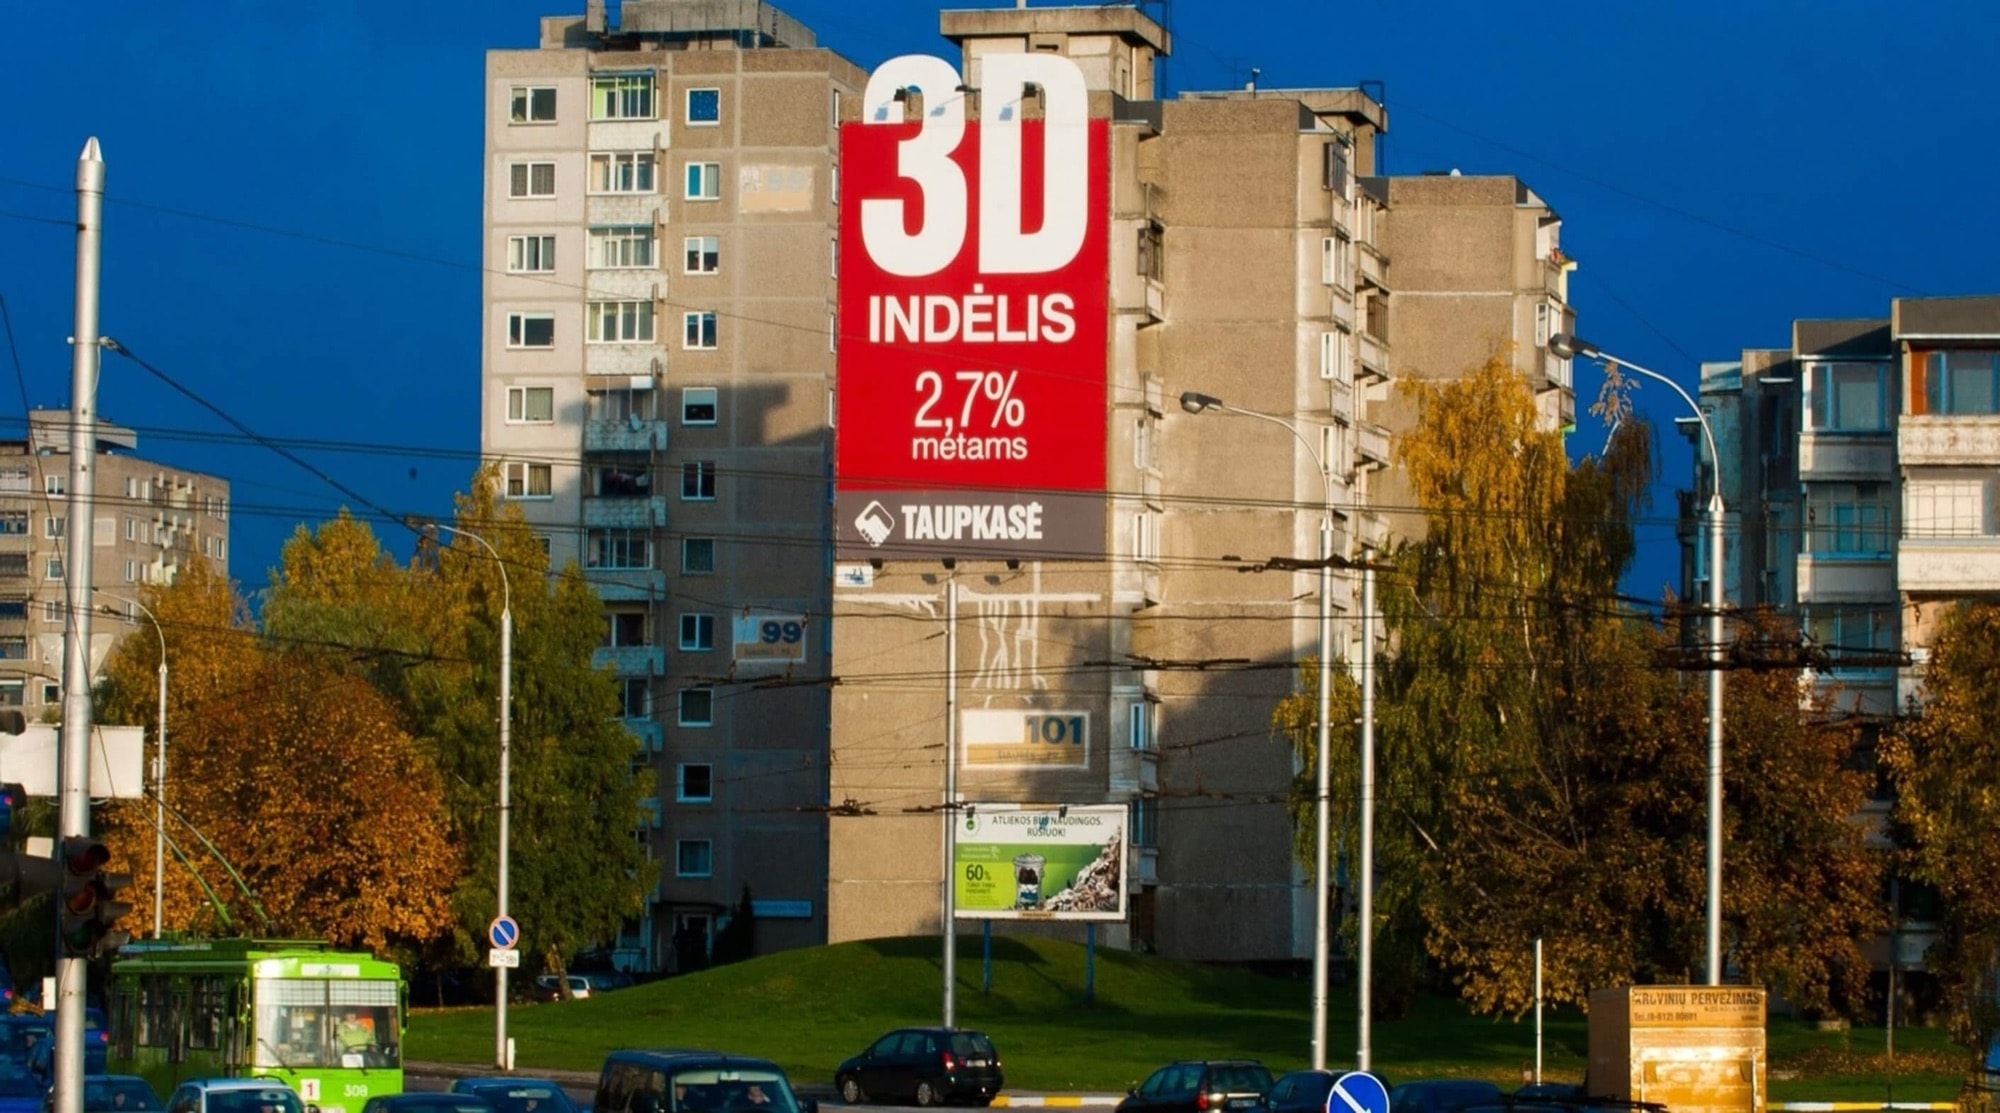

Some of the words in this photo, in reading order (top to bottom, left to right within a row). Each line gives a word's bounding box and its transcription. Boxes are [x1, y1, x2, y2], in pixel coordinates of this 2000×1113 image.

[861, 52, 1089, 277] 3D
[868, 283, 1076, 343] INDĖLIS
[914, 370, 1025, 435] 2,7%
[901, 501, 1043, 540] TAUPKASĖ
[762, 621, 802, 645] 99
[1026, 715, 1082, 745] 101
[992, 815, 1032, 825] ATLIEKOS
[1050, 816, 1103, 826] NAUDINGOS.
[1690, 989, 1760, 1005] PERVEŽIMAS
[306, 1082, 314, 1097] 1
